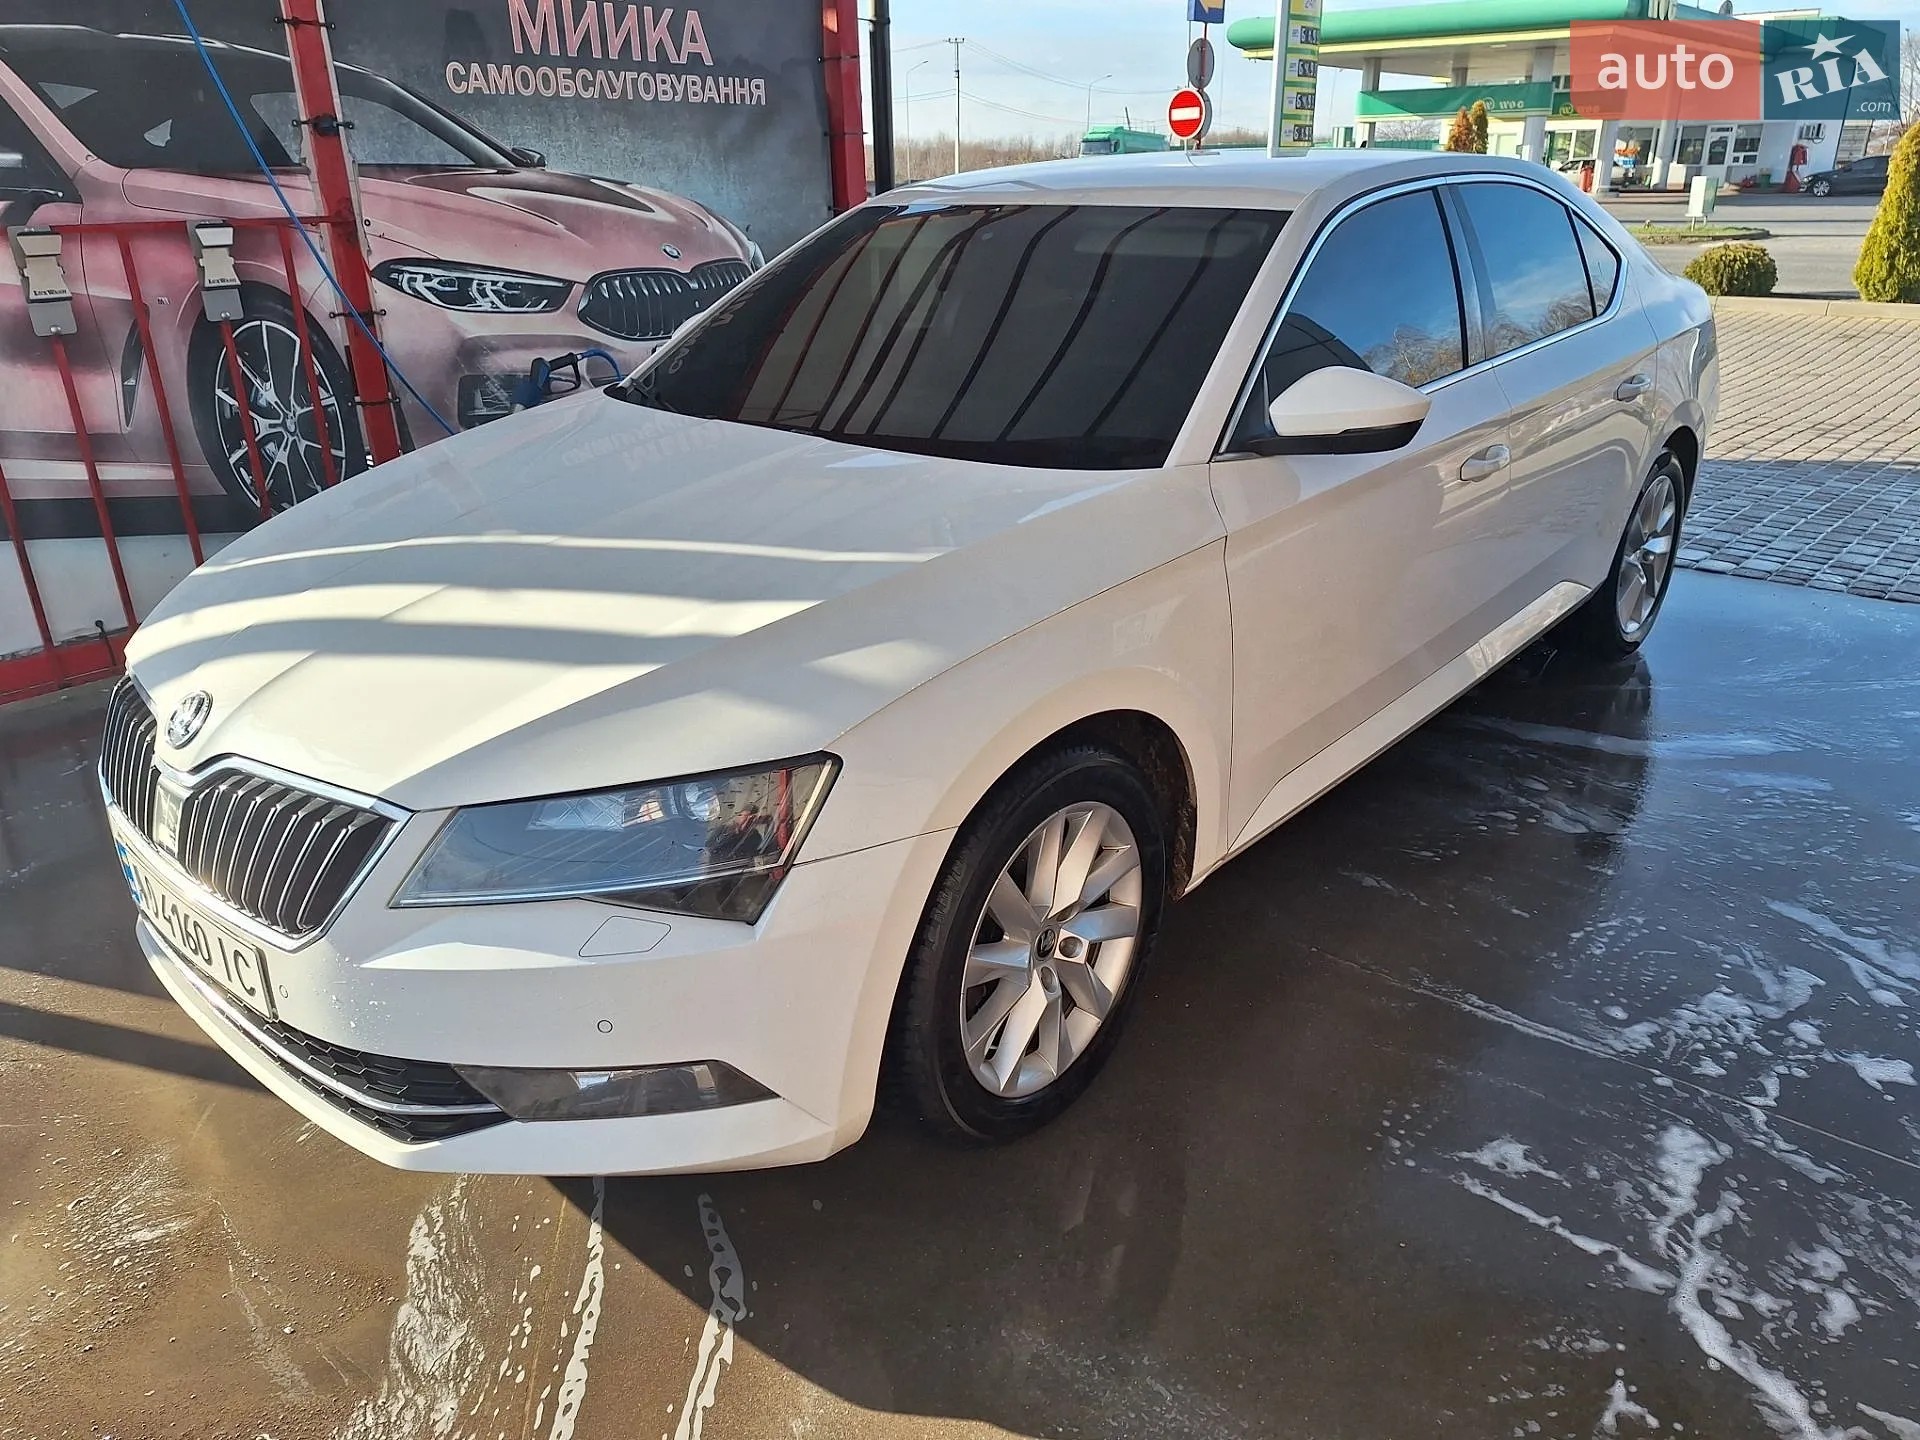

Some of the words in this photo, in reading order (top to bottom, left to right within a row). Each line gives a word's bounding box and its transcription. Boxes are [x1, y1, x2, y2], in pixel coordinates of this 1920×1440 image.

[445, 61, 766, 106] САМООБСЛУГОВУВАННЯ
[161, 894, 214, 967] 4160
[217, 935, 257, 998] IC
